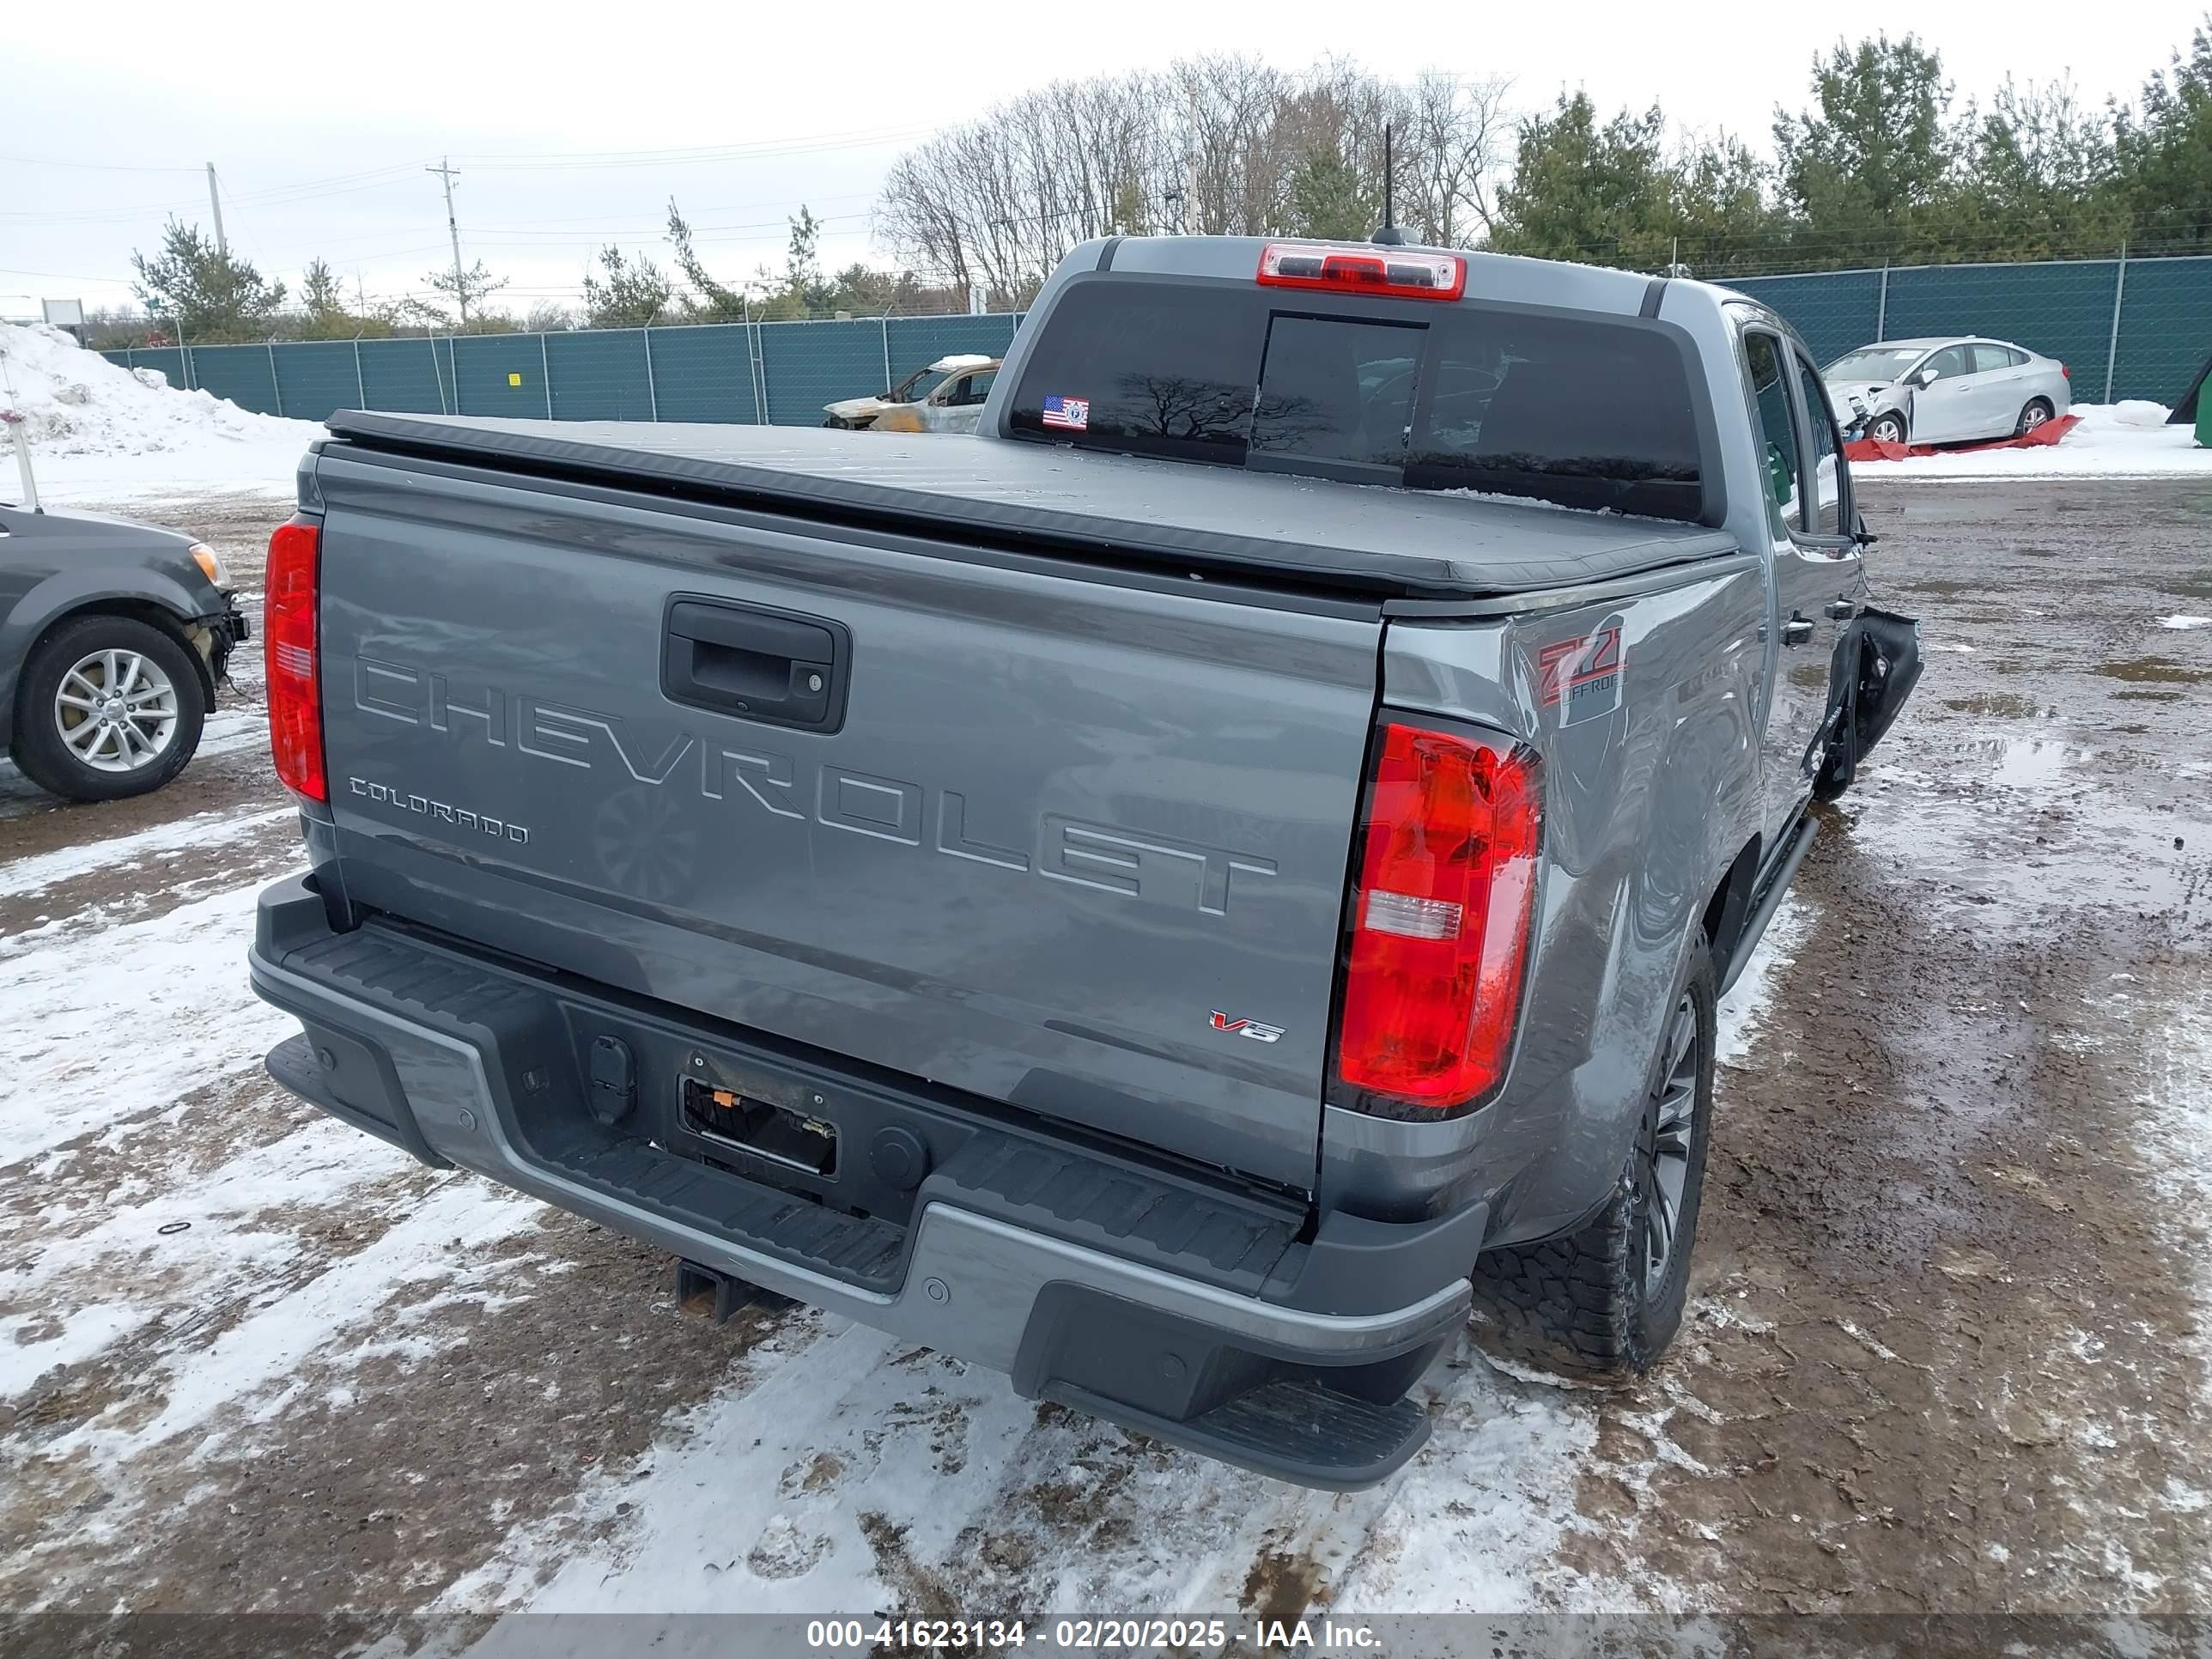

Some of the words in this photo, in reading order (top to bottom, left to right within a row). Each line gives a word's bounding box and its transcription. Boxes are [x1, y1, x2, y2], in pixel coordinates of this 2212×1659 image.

[349, 776, 530, 845] COLORADO
[355, 654, 1278, 916] CHEVROLET
[1209, 1009, 1286, 1044] V6
